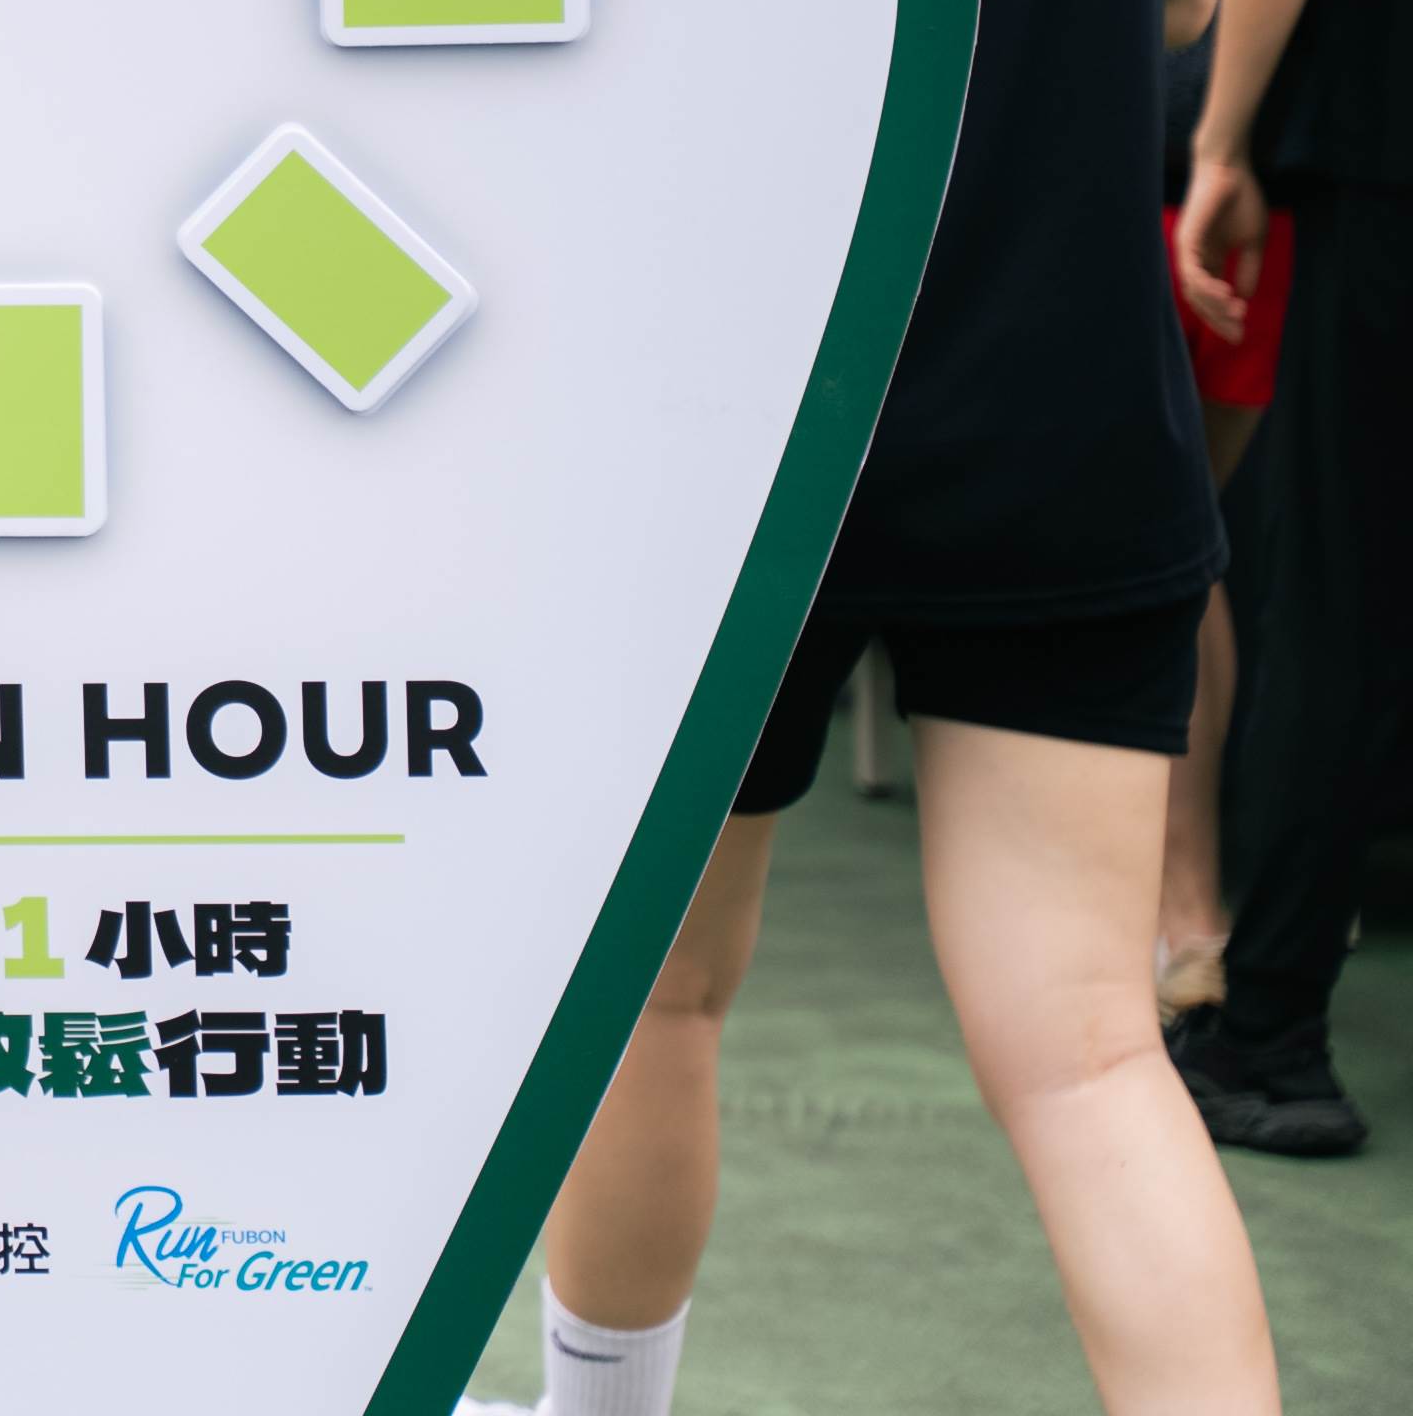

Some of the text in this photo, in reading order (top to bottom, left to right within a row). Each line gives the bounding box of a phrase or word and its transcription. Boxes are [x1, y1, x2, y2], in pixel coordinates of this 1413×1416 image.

[81, 679, 489, 782] HOUR
[114, 1185, 287, 1287] Run FUBON
[176, 1263, 230, 1288] For
[236, 1250, 369, 1292] Green
